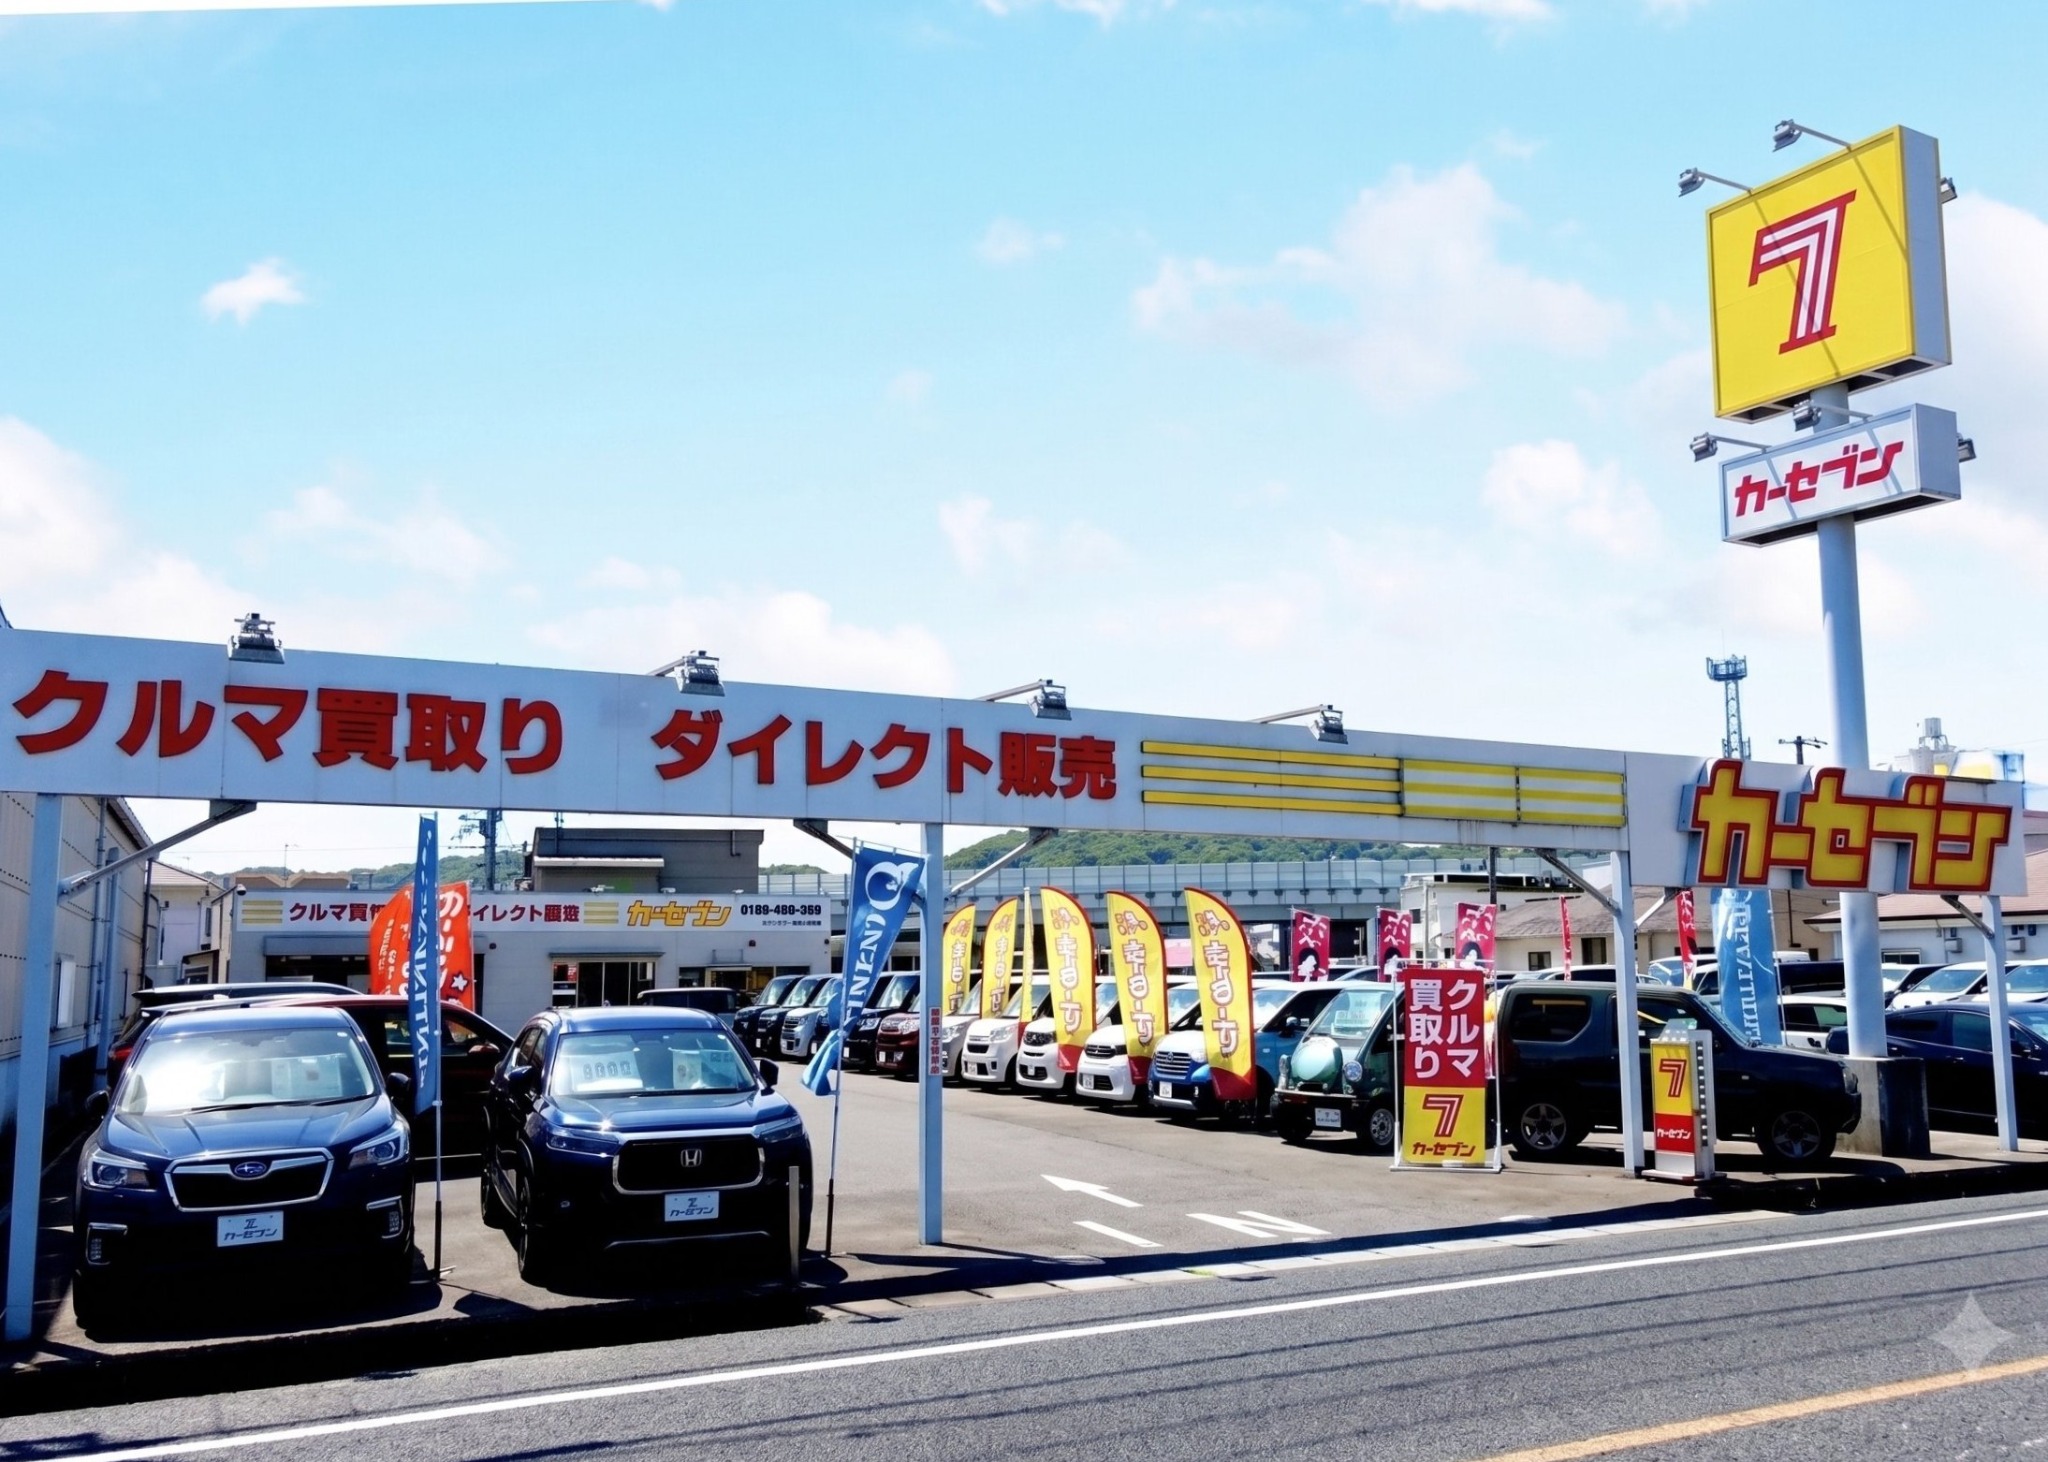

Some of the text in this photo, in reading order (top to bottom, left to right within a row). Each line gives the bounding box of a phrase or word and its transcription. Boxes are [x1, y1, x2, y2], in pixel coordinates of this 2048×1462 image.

[1748, 189, 1857, 355] 7
[1734, 440, 1904, 517] カーセブン
[12, 669, 1116, 800] クルマ買取り ダイレクト販売
[1691, 759, 2013, 891] カーセブン
[1409, 979, 1443, 1079] 買取り
[1446, 979, 1480, 1078] クルマ
[1422, 1094, 1464, 1138] 7
[1659, 1059, 1687, 1098] 7
[1412, 1141, 1476, 1157] カーセブン
